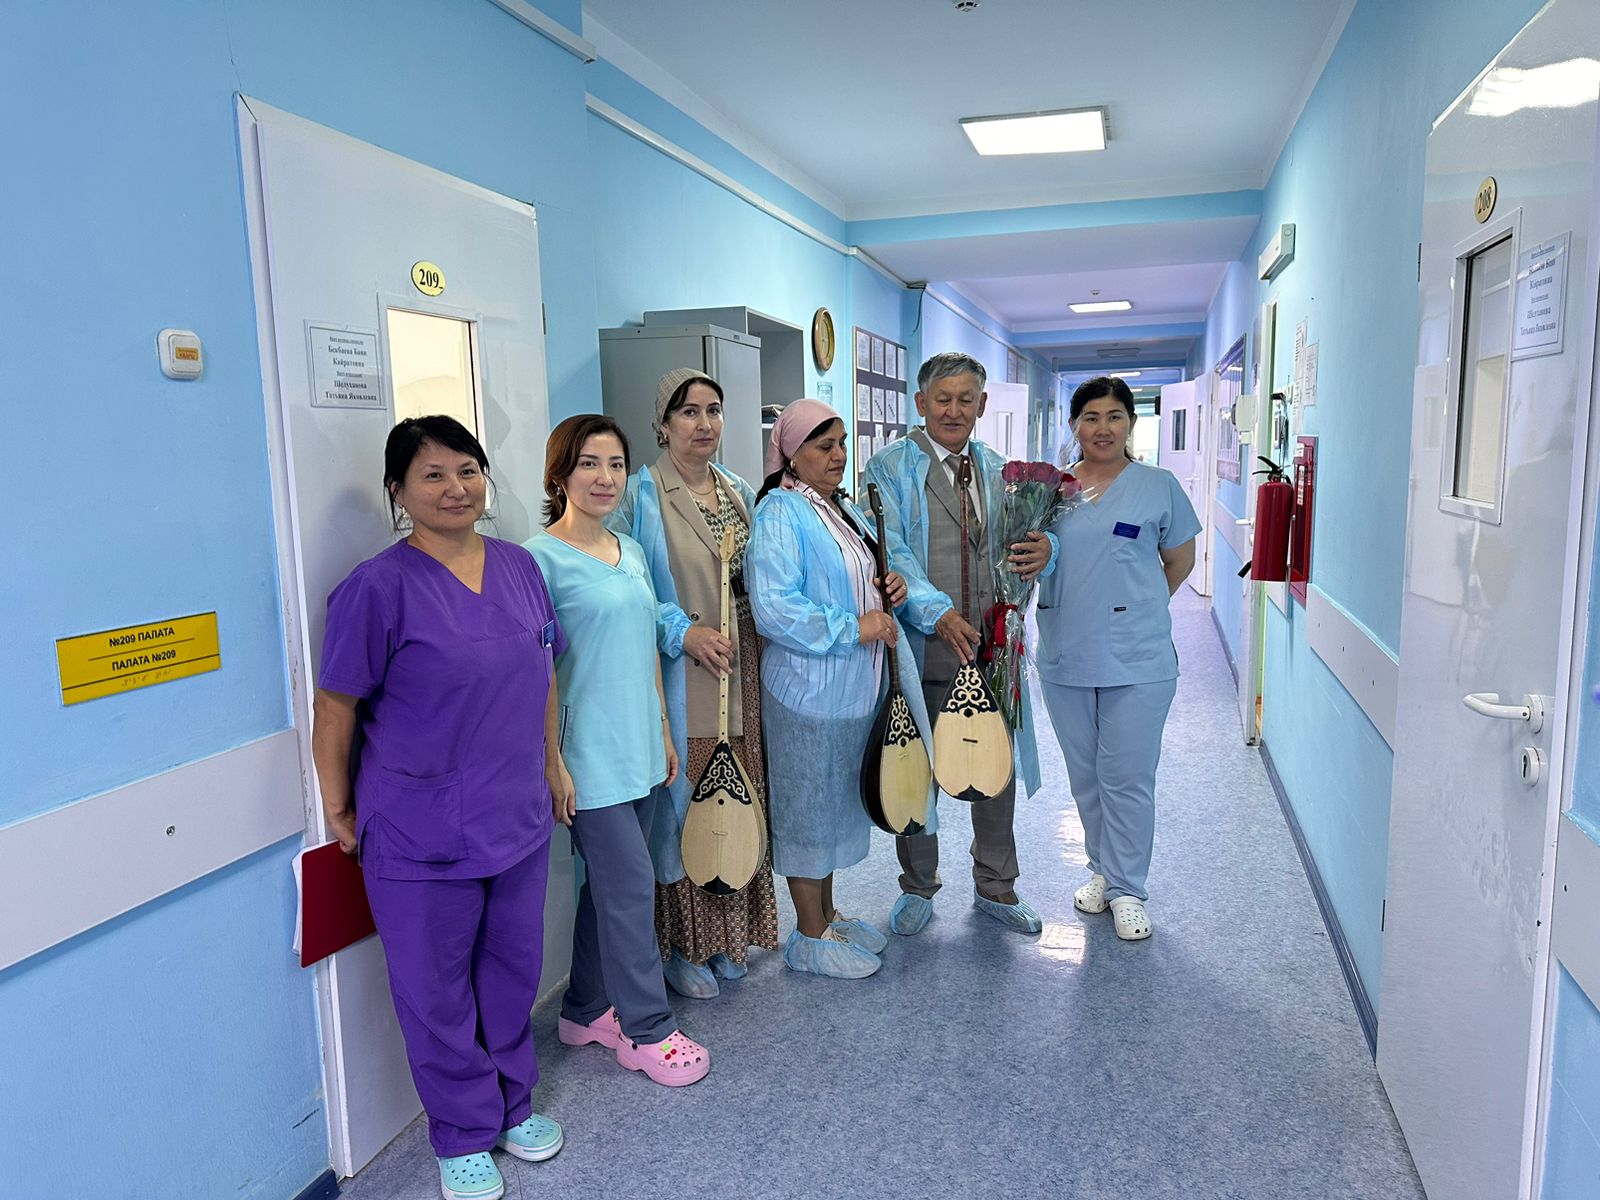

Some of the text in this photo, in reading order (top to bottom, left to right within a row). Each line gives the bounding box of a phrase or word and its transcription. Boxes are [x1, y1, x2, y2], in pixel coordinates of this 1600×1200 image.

[1477, 186, 1492, 214] 208
[419, 268, 439, 289] 209
[109, 627, 175, 647] №209 ПАЛАТА
[112, 649, 176, 671] ПАЛАТА №209
